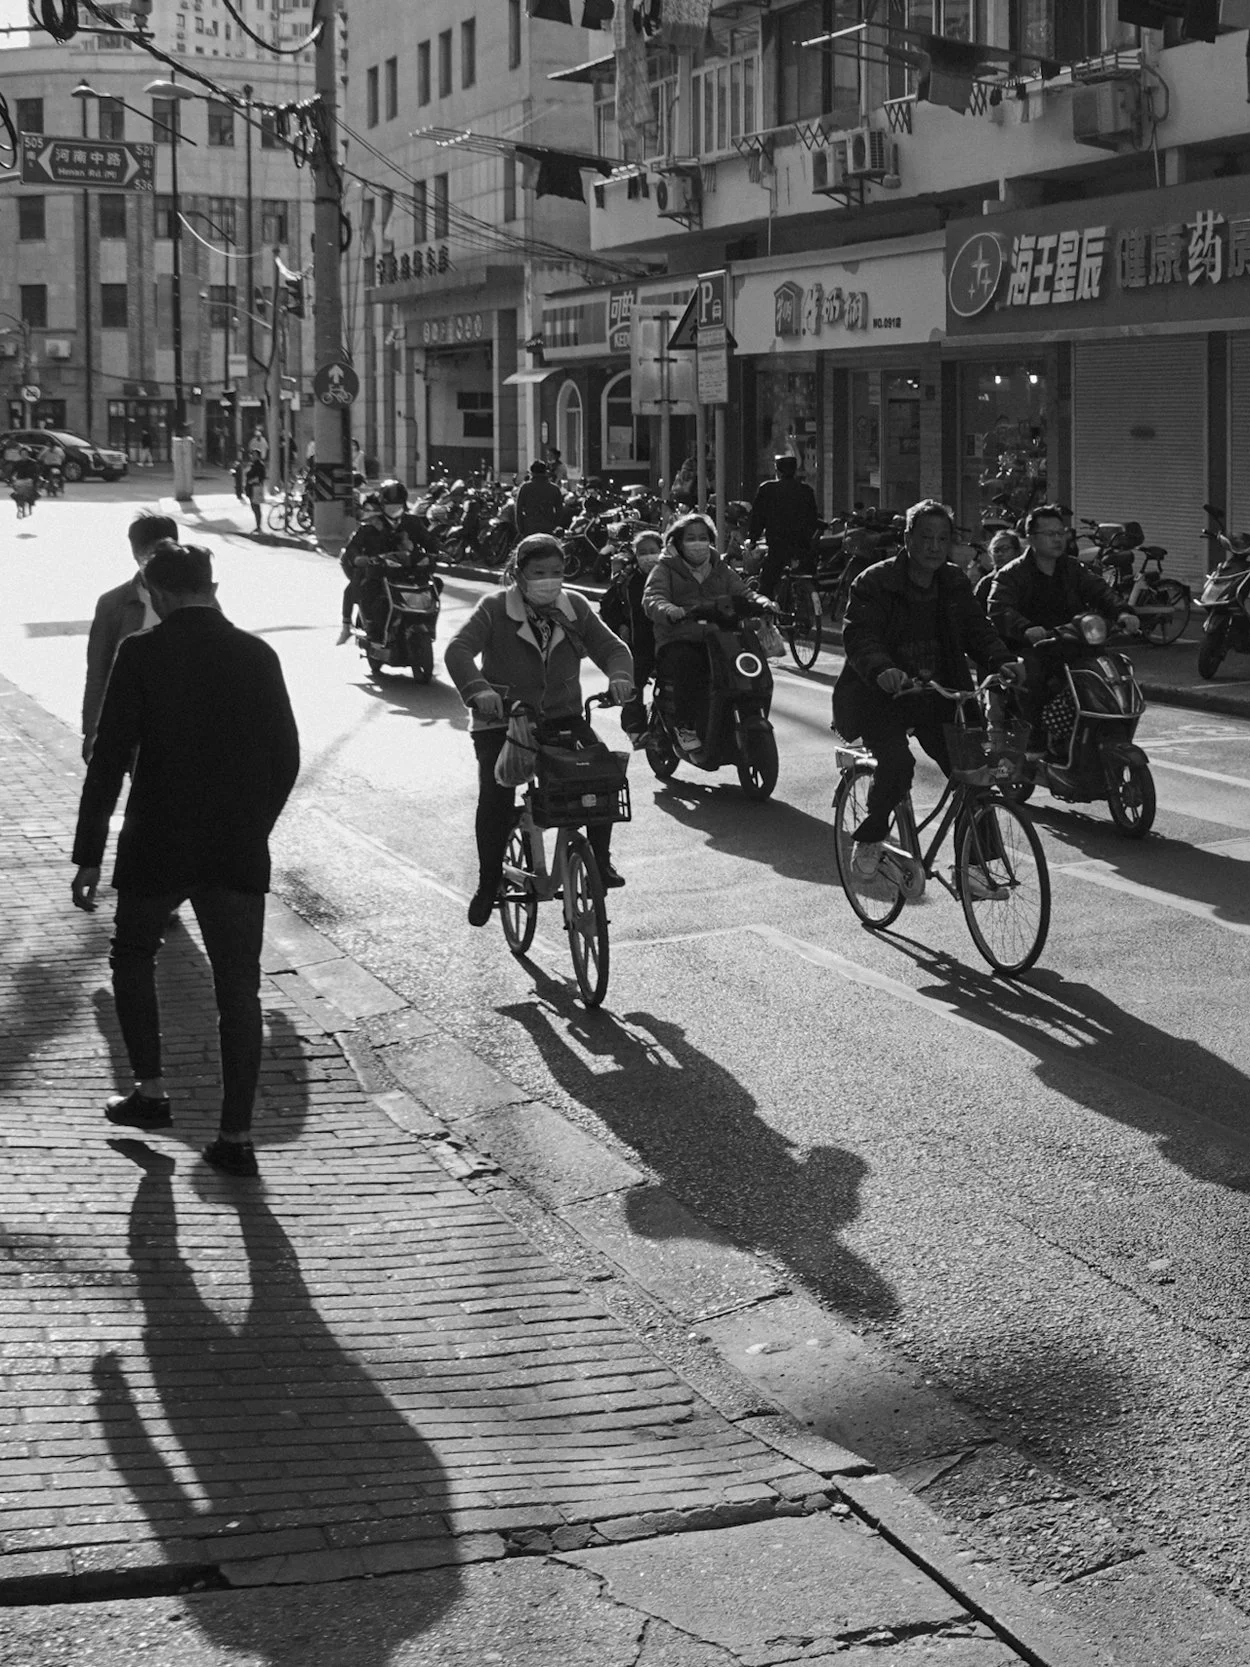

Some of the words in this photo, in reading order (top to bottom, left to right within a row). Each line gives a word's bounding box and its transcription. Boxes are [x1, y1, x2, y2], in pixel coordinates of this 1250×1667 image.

[24, 137, 44, 149] 505
[135, 145, 155, 157] 521
[55, 148, 121, 168] 河南中路
[134, 179, 154, 192] 536
[1007, 225, 1107, 307] 海王星辰
[700, 280, 714, 324] P
